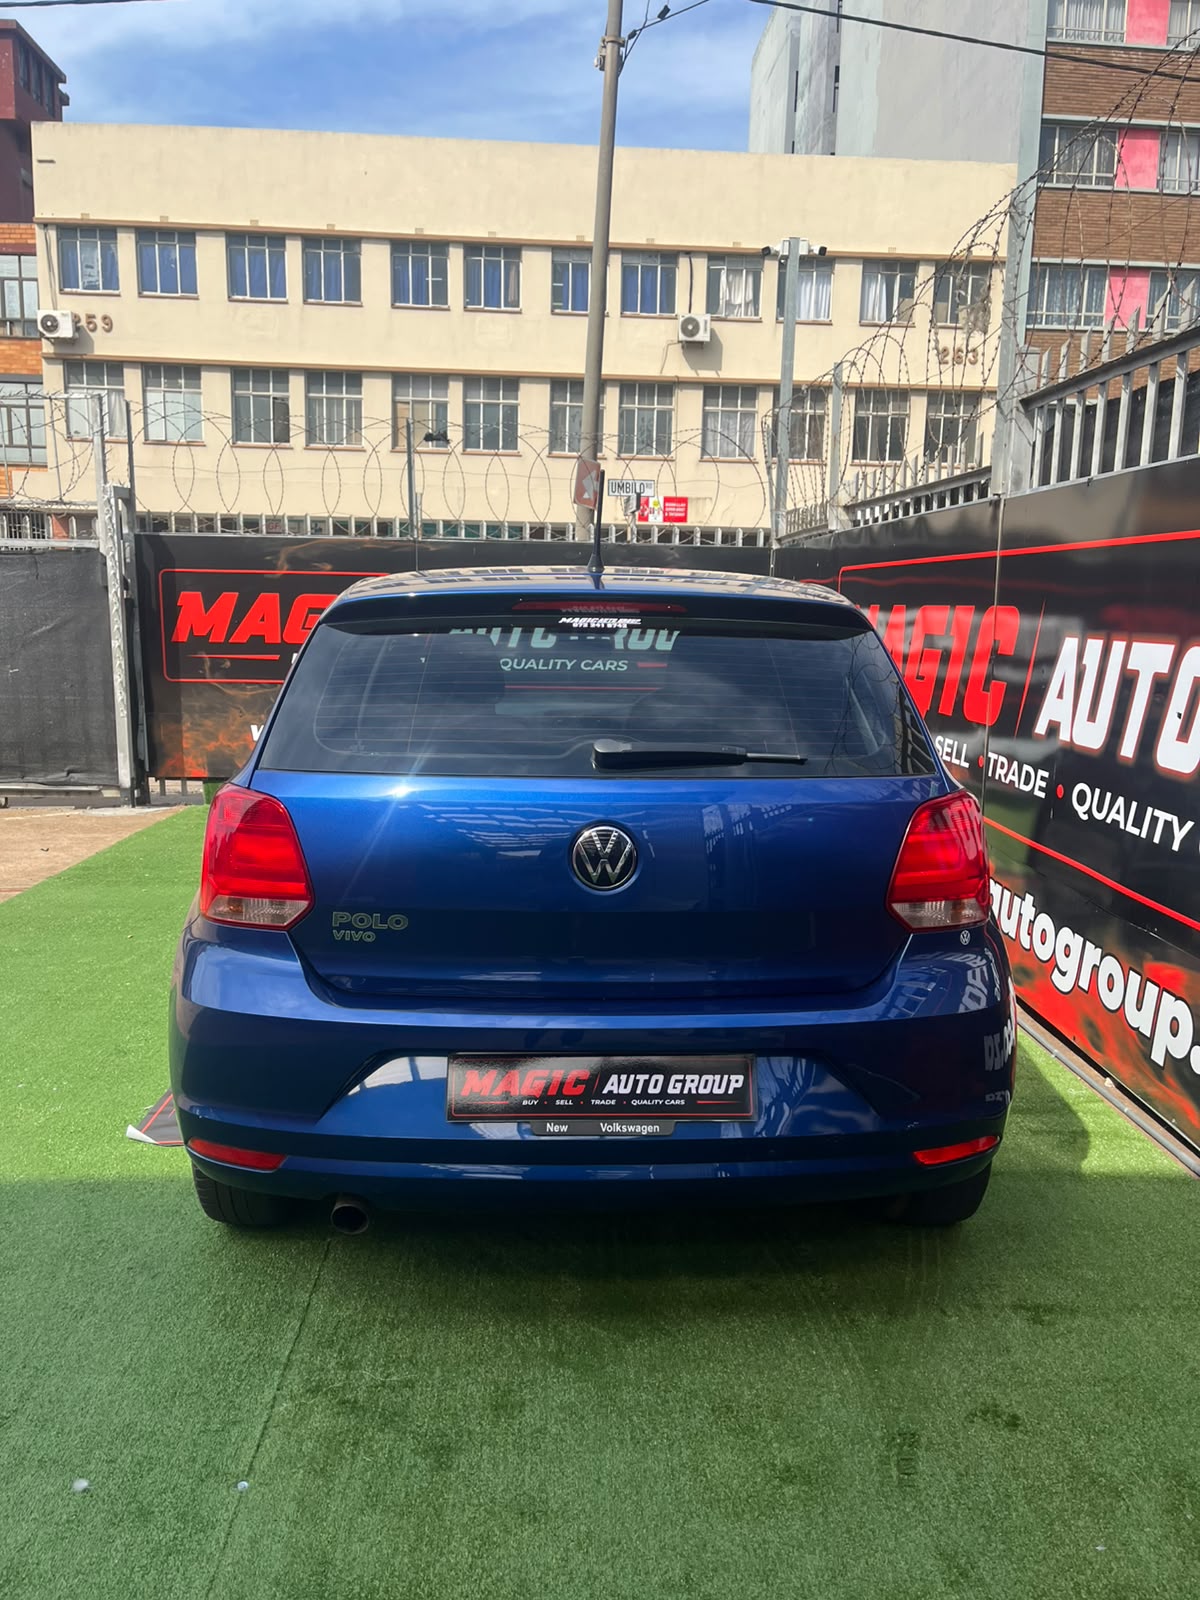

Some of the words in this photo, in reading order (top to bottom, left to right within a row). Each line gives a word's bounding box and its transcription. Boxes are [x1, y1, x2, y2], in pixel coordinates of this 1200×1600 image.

[940, 346, 979, 365] 263
[610, 481, 646, 495] UMBILO
[500, 656, 577, 671] QUALITY
[580, 658, 629, 672] CARS
[935, 735, 970, 769] SELL
[987, 751, 1050, 799] TRADE
[1071, 782, 1195, 853] QUALITY
[331, 911, 409, 931] POLO
[332, 929, 377, 943] VIVO
[460, 1069, 591, 1098] MAGIC
[601, 1073, 664, 1095] AUTO
[667, 1073, 745, 1095] GROUP
[546, 1122, 569, 1133] New
[599, 1122, 660, 1135] Volkswagen
